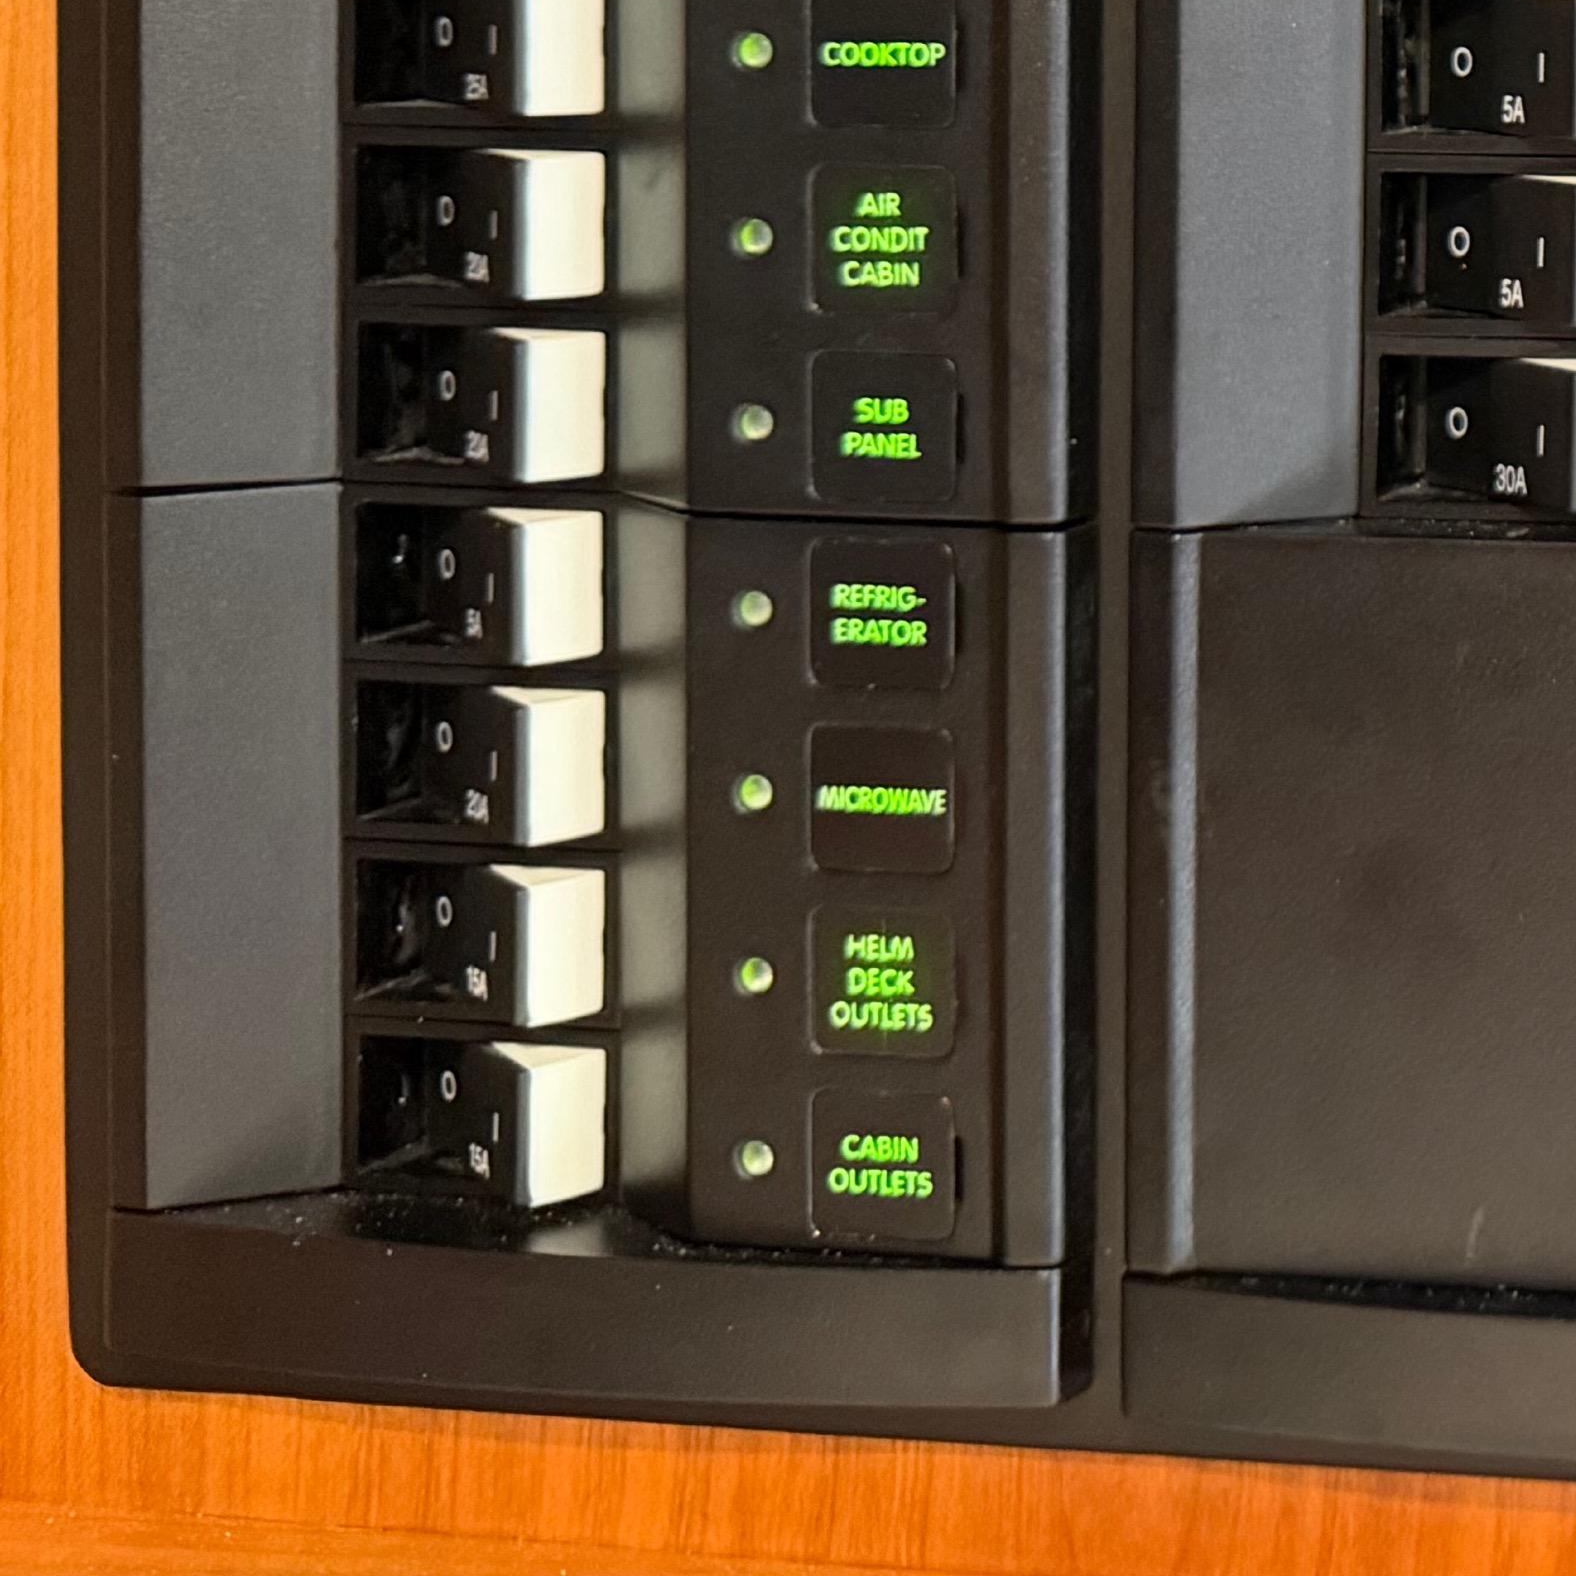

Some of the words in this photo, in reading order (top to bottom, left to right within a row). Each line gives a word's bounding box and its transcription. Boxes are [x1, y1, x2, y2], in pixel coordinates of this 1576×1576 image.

[822, 42, 945, 67] COOKTOP
[856, 193, 900, 217] AIR
[832, 226, 928, 253] CONDIT
[841, 261, 919, 287] CABIN
[854, 398, 909, 424] SUB
[842, 432, 921, 459] PANEL
[832, 584, 926, 611] REFRIG-
[832, 618, 926, 645] ERATOR
[818, 786, 946, 815] MICROWAVE
[845, 935, 914, 963] HELM
[847, 967, 914, 997] DECK
[830, 1001, 932, 1031] OUTLETS
[841, 1135, 918, 1162] CABIN
[828, 1168, 932, 1197] OUTLETS
